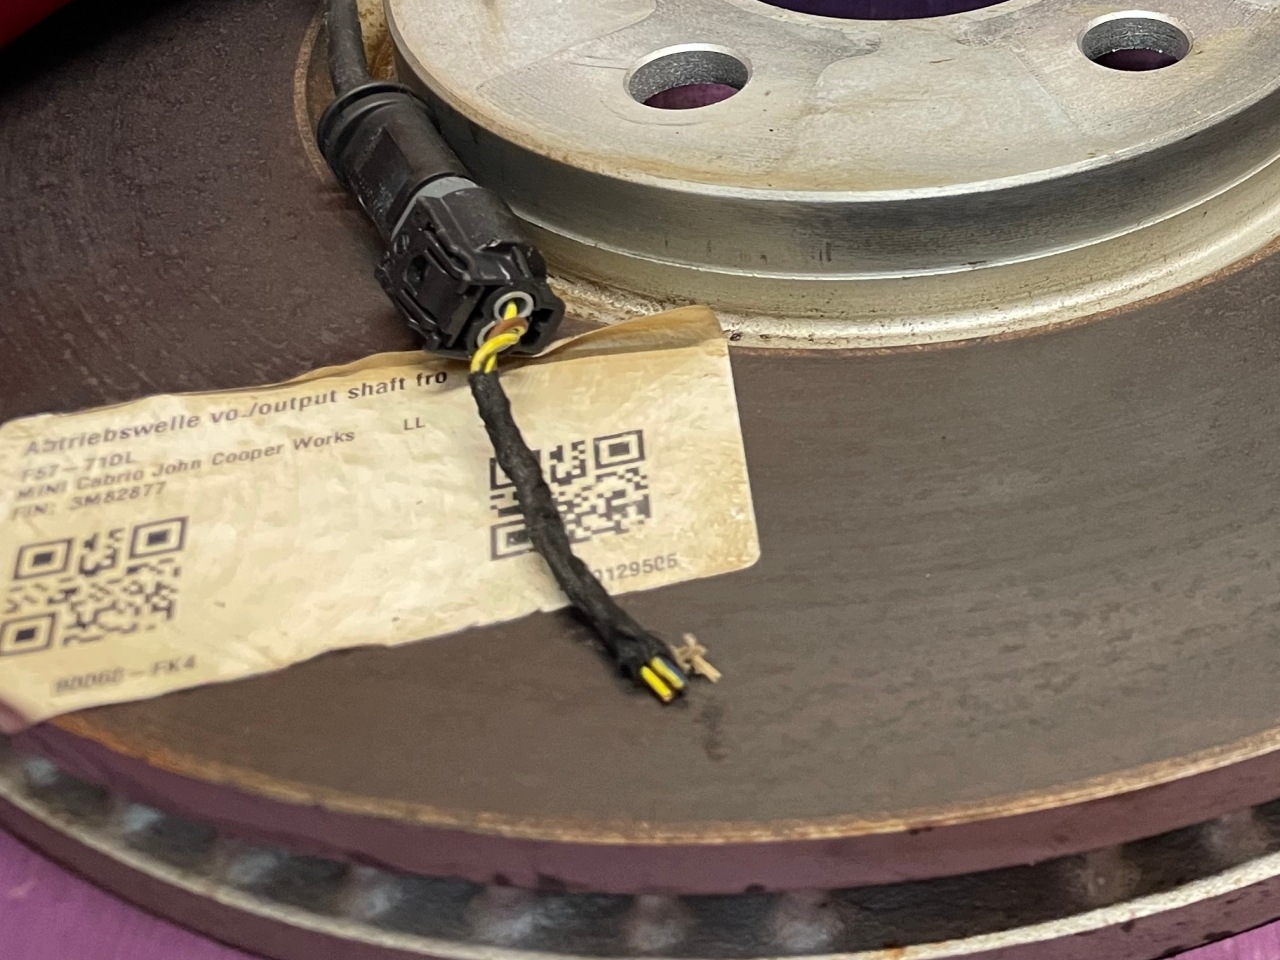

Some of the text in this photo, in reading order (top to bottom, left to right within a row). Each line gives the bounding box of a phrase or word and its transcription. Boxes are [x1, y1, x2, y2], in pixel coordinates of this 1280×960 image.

[347, 377, 405, 400] shaft
[15, 479, 68, 501] MINI
[76, 468, 145, 491] Cabrio
[152, 458, 201, 478] John
[212, 443, 284, 466] Cooper
[293, 431, 356, 451] Works
